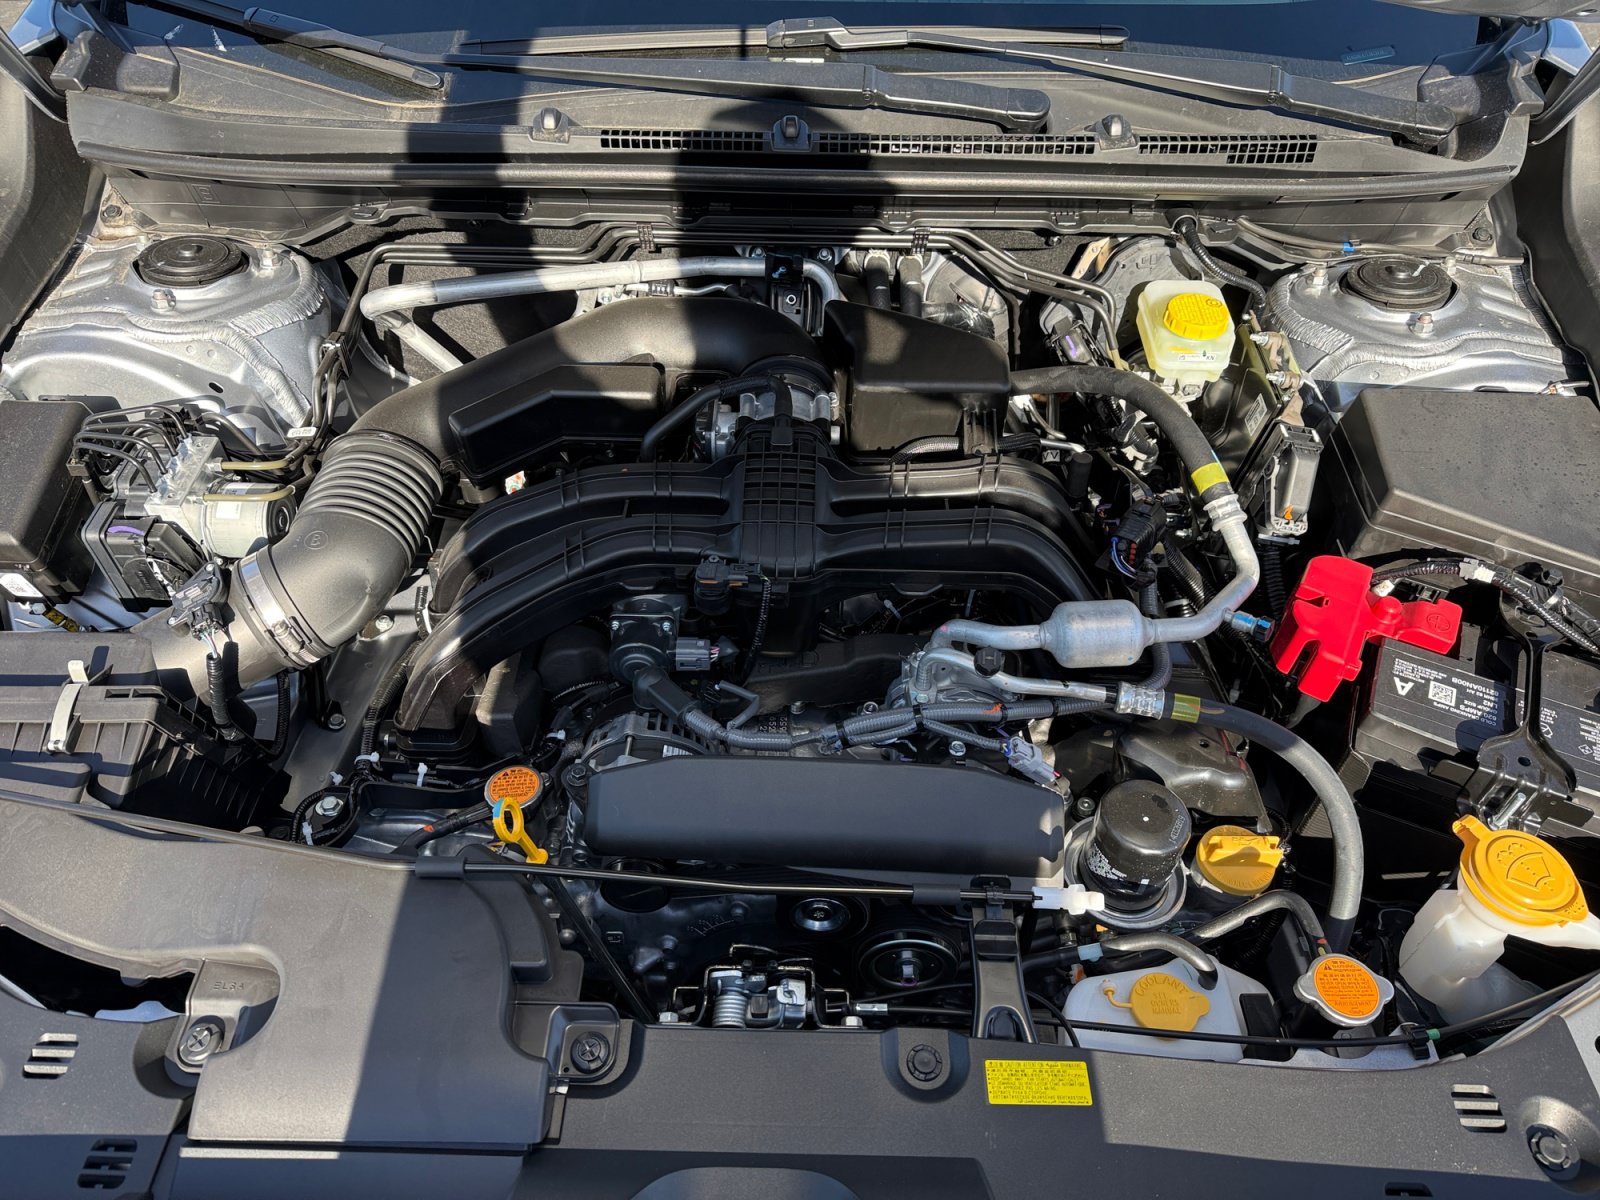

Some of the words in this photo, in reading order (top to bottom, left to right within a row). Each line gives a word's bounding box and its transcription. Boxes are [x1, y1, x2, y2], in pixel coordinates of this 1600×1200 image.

[1393, 676, 1415, 696] A
[1463, 699, 1477, 707] SIZE
[1482, 700, 1498, 709] LN2
[1450, 707, 1480, 721] CRANKING
[1459, 704, 1482, 716] AMPS
[1480, 717, 1497, 726] COLD
[1134, 975, 1189, 997] COOLANT
